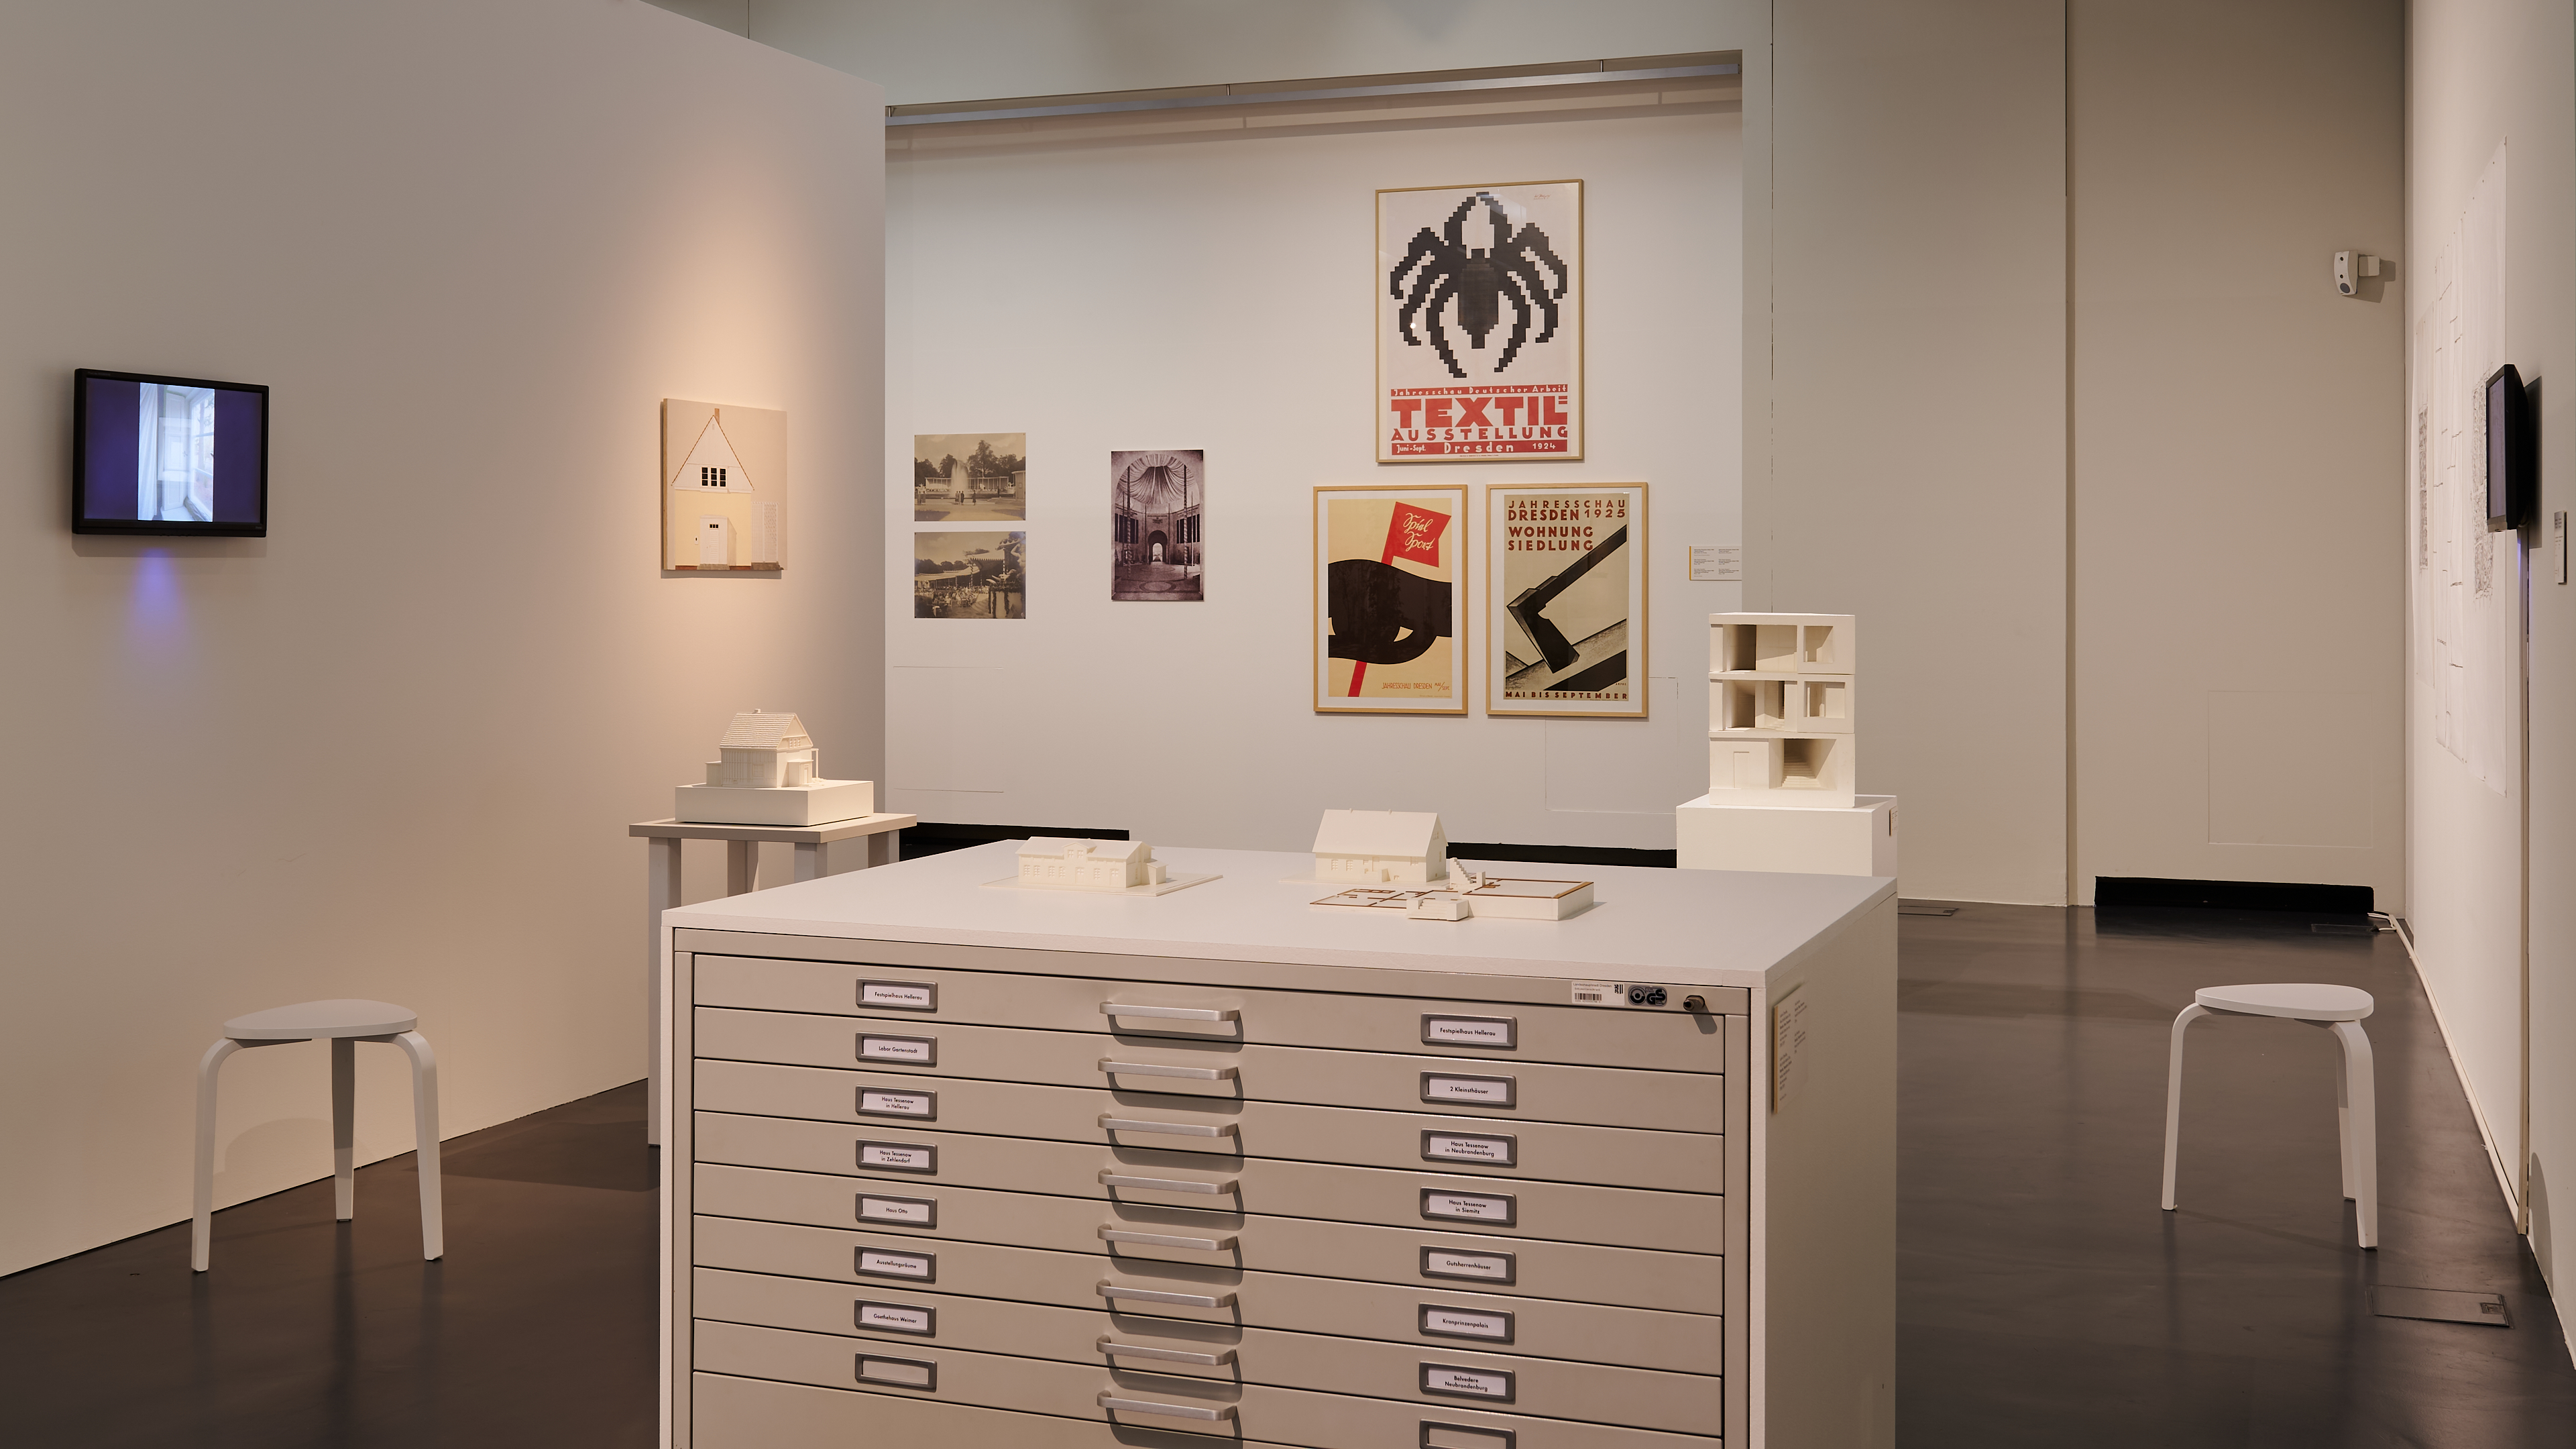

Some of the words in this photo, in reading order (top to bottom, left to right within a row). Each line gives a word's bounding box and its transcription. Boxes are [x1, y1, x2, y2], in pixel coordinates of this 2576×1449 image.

[1394, 388, 1462, 396] Jahresschau
[1469, 386, 1528, 394] Deutscher
[1532, 384, 1567, 393] Arbeit
[1391, 426, 1568, 441] AUSSTELLUNG
[1444, 442, 1514, 453] Dresden
[1532, 442, 1556, 450] 1924
[1508, 499, 1626, 508] JAHRESSCHAU
[1508, 508, 1579, 521] DRESDEN
[1584, 508, 1626, 518] 1925
[1403, 513, 1429, 533] Spiel
[1508, 526, 1593, 537] WOHNUNG
[1404, 531, 1435, 552] Sport
[1508, 539, 1593, 551] SIEDLUNG
[1555, 692, 1627, 700] SEPTEMBER
[1440, 1027, 1473, 1035] Festspielhaus
[1451, 1148, 1494, 1158] Neubrandenburg
[1463, 1200, 1487, 1208] Tessenow
[876, 1259, 917, 1269] Ausstellungsräume
[1446, 1260, 1491, 1270] Gutsherrenhäuser
[873, 1313, 899, 1322] Goethehaus
[1443, 1318, 1489, 1328] Kronprinzenpalais
[1445, 1381, 1488, 1392] Neubrandenburg
